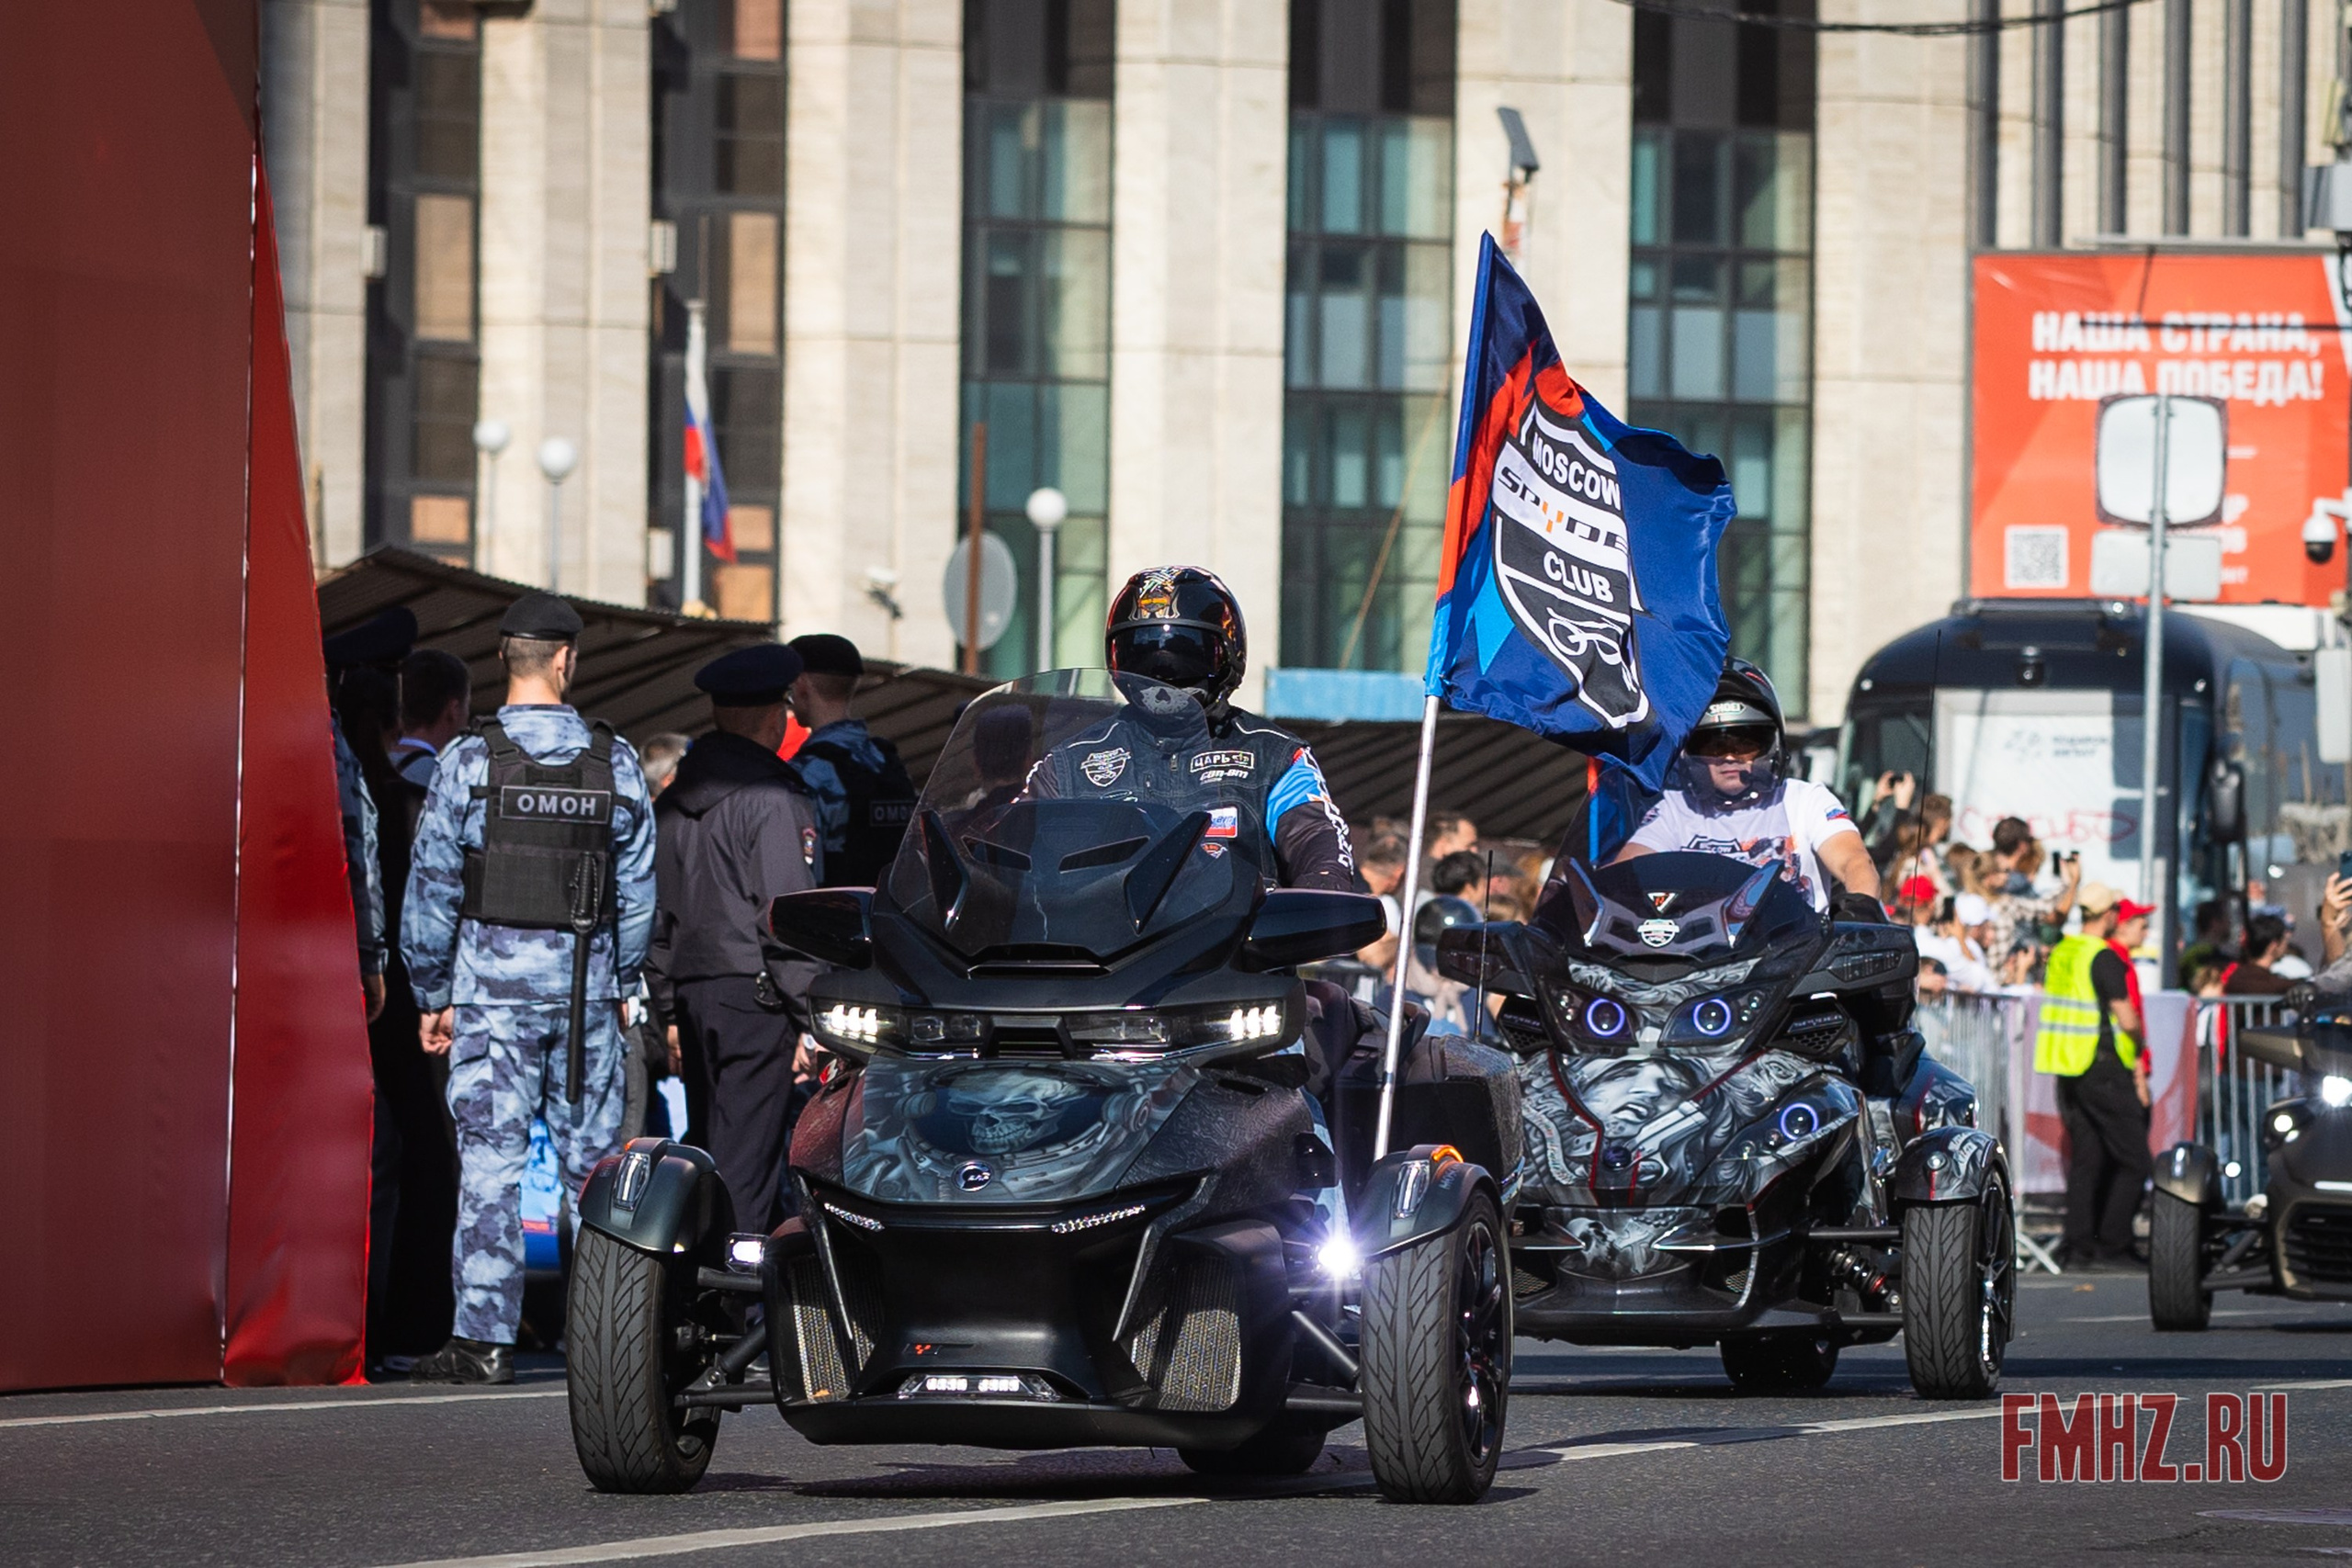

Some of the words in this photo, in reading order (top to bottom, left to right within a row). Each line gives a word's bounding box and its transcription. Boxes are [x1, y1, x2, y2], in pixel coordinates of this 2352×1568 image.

[2032, 310, 2151, 352] НАША
[2160, 310, 2321, 358] СТРАНА,
[2029, 359, 2146, 400] НАША
[2156, 359, 2324, 407] ПОБЕДА!
[1532, 432, 1622, 511] MOSCOW
[1543, 550, 1614, 603] CLUB
[1709, 702, 1741, 714] SHOEI
[1194, 754, 1230, 767] ЦАРЬ
[516, 794, 596, 817] ОМОН
